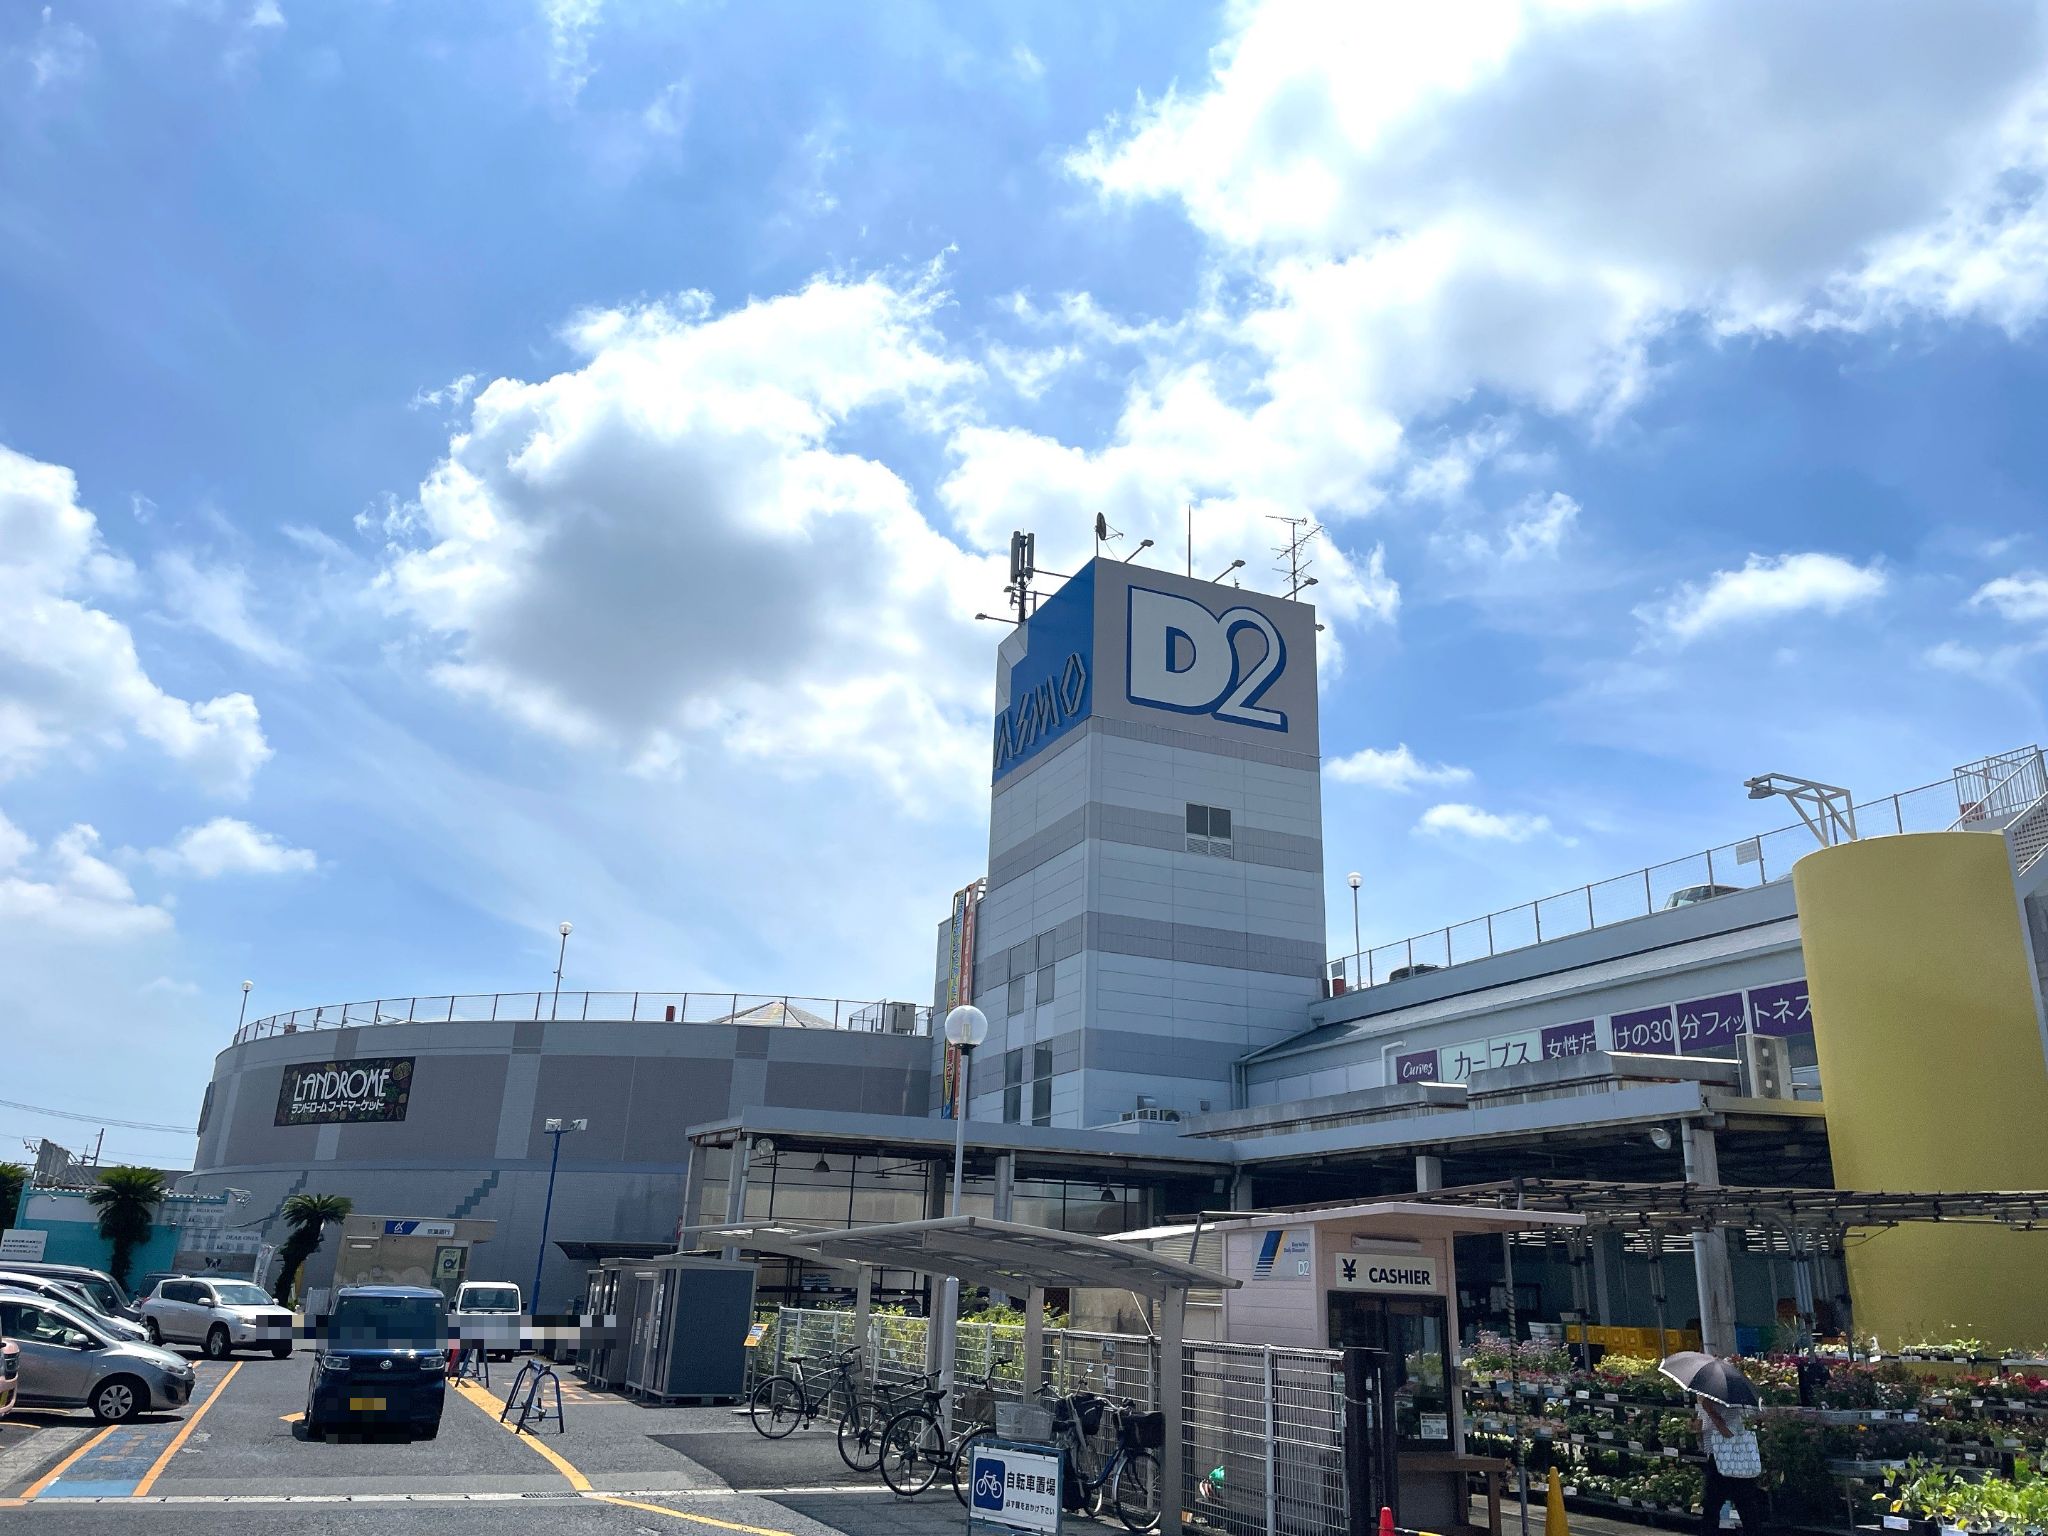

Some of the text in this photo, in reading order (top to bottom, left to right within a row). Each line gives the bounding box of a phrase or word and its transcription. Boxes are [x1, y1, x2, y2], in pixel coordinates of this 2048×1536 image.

[1126, 585, 1288, 733] D2
[1402, 1061, 1433, 1078] Curves
[1454, 1042, 1531, 1081] カーブス
[294, 1068, 390, 1102] LANDROME
[1298, 1260, 1310, 1276] D2
[1368, 1267, 1431, 1285] CASHIER
[1006, 1471, 1056, 1496] 自転車置場
